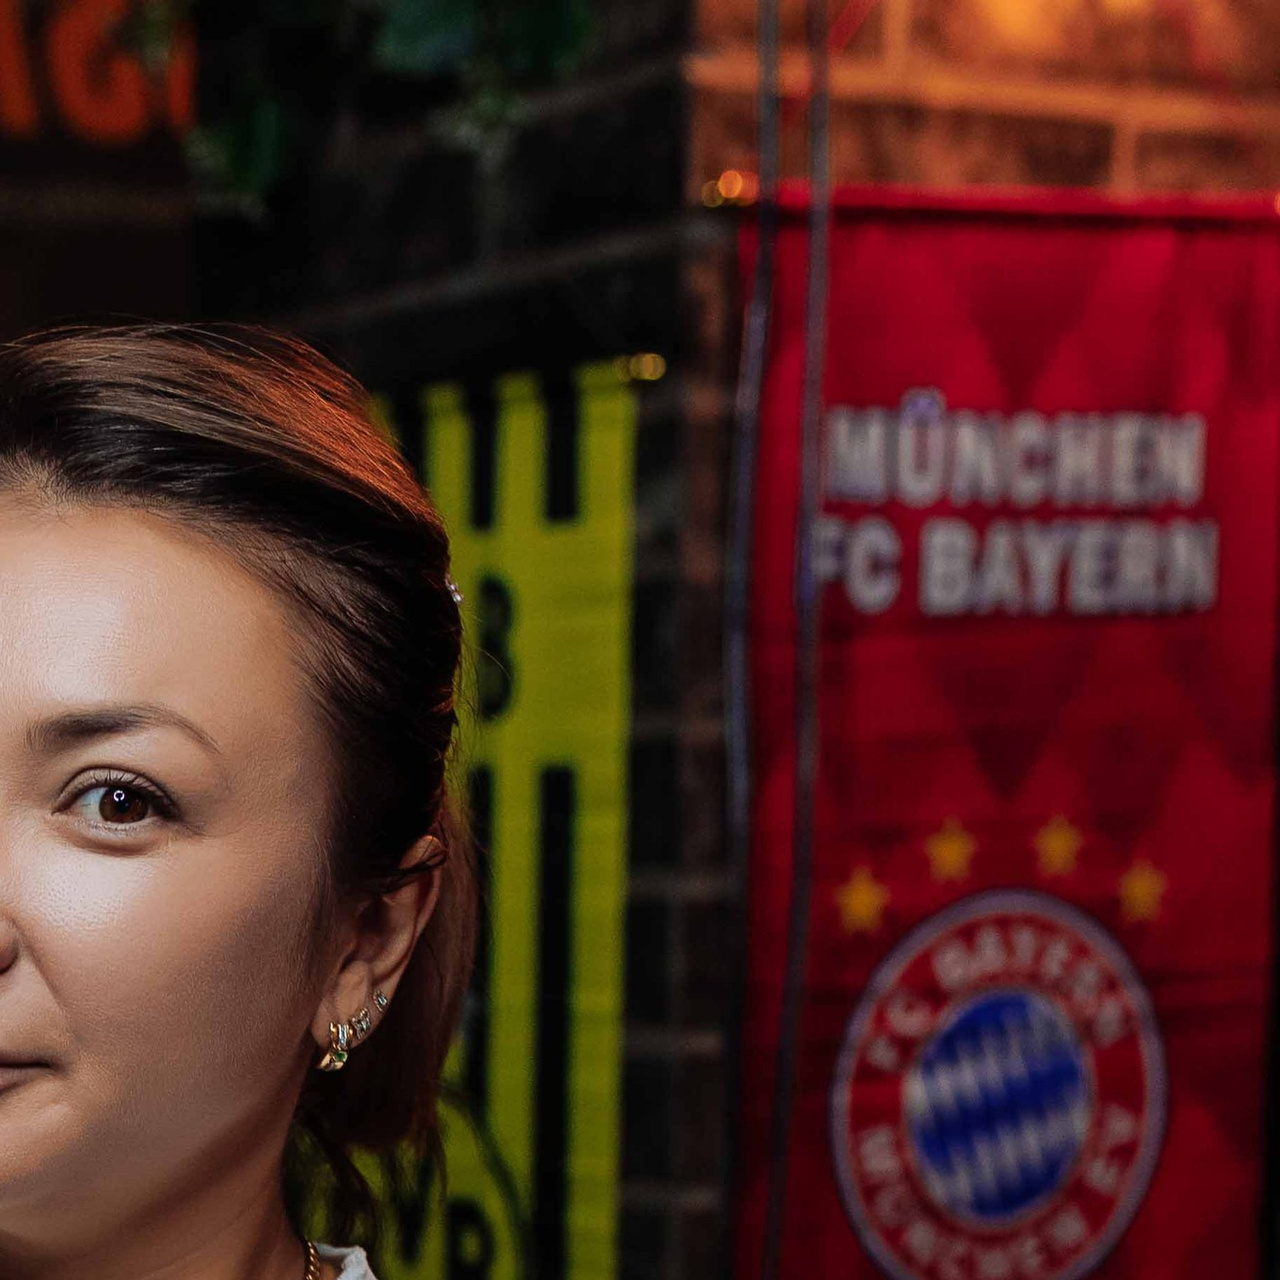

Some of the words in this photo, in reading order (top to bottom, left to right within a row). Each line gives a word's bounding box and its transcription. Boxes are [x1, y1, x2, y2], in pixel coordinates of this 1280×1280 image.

[825, 388, 1207, 506] MÜNCHEN
[809, 514, 902, 612] FC
[919, 515, 1219, 616] BAYERN
